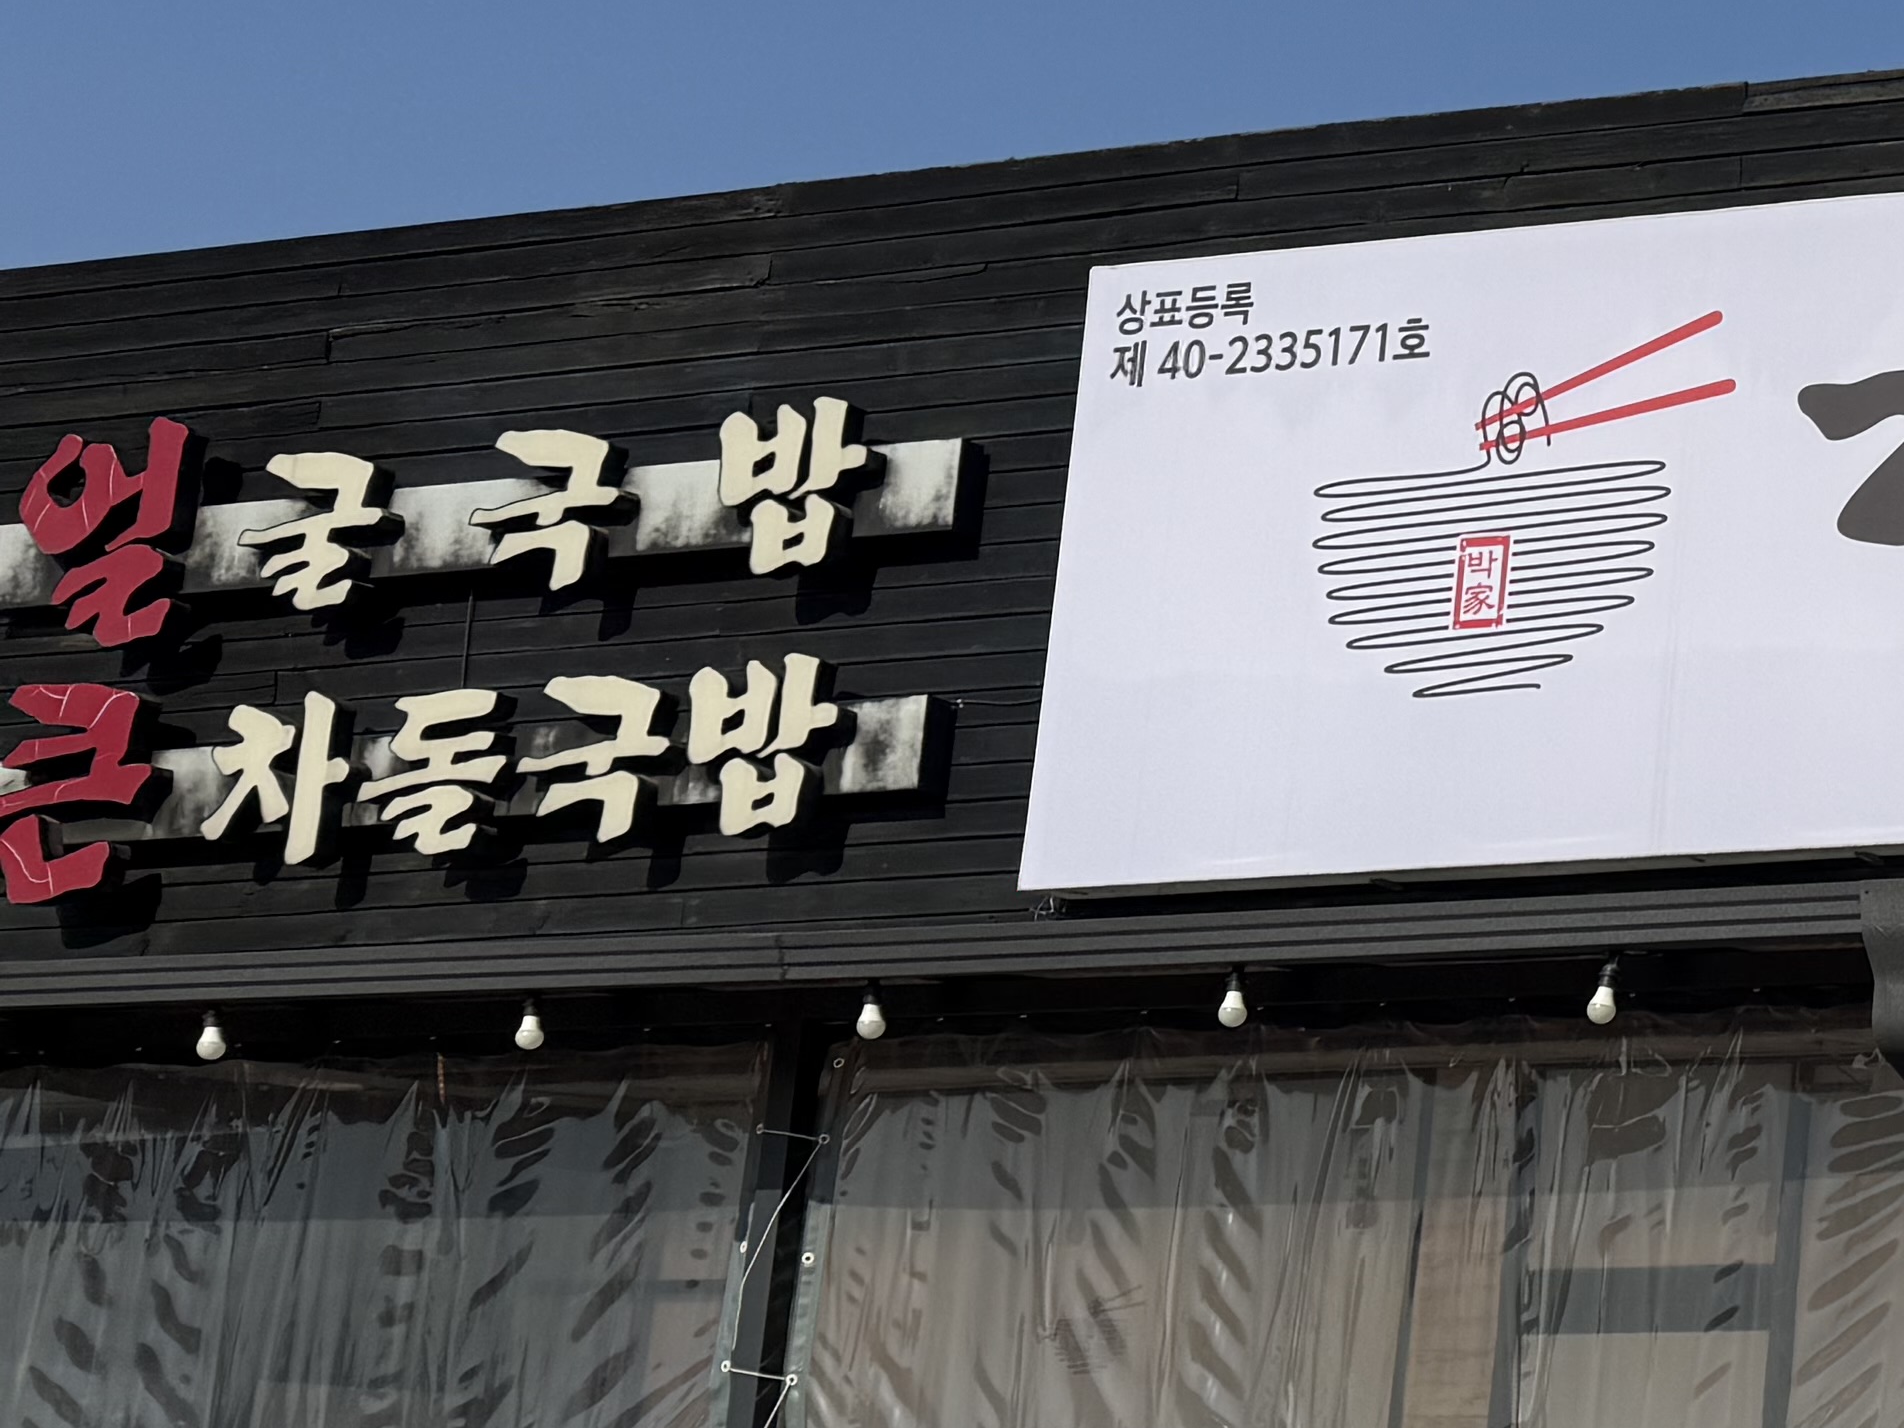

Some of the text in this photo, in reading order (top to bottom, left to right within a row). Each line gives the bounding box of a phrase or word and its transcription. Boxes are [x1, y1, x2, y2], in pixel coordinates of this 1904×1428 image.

[1116, 281, 1254, 335] 상표등록
[1109, 317, 1431, 388] 제 40-2335171호
